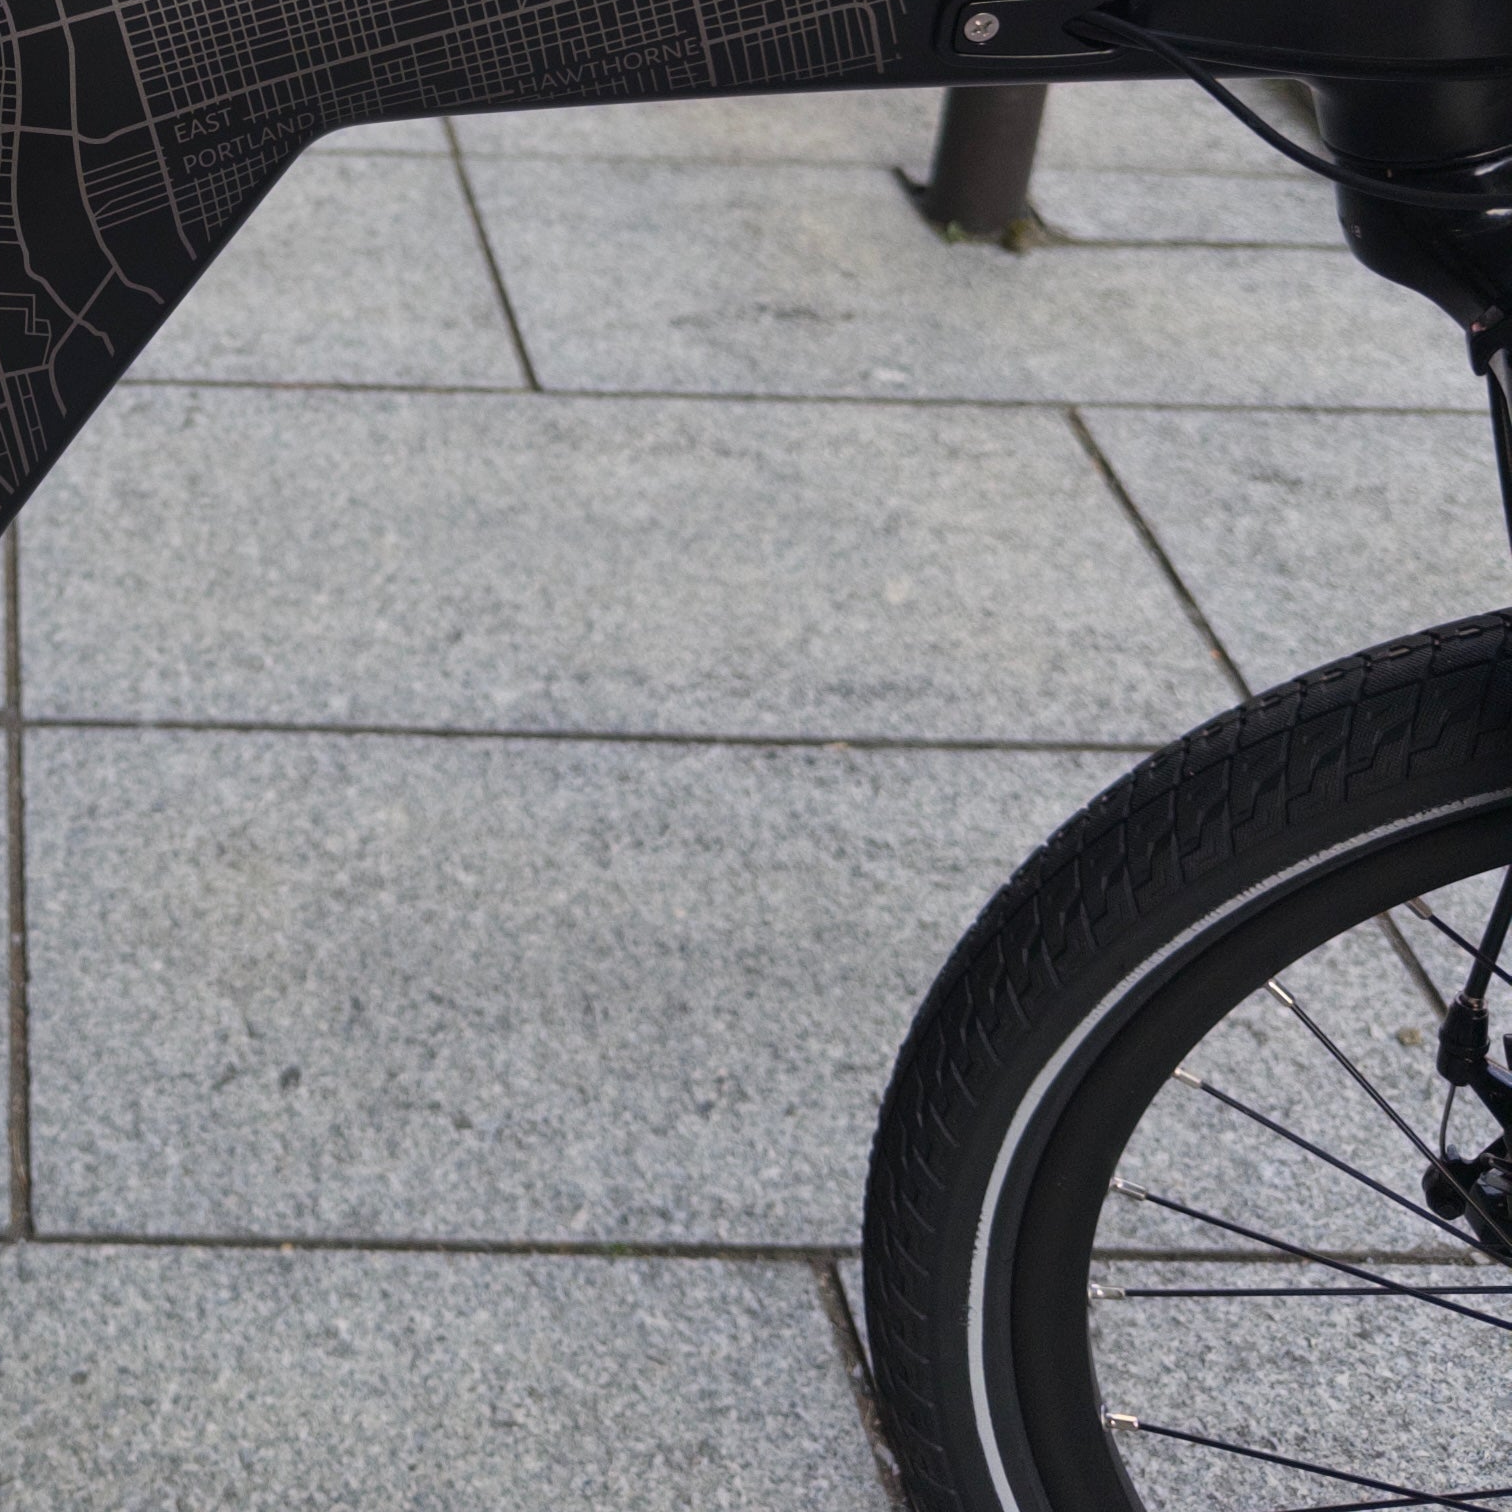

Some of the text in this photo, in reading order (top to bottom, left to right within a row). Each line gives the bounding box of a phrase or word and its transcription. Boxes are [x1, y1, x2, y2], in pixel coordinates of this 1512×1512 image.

[518, 36, 701, 95] HAWTHORNE
[174, 107, 232, 144] EAST
[182, 112, 316, 175] PORTLAND
